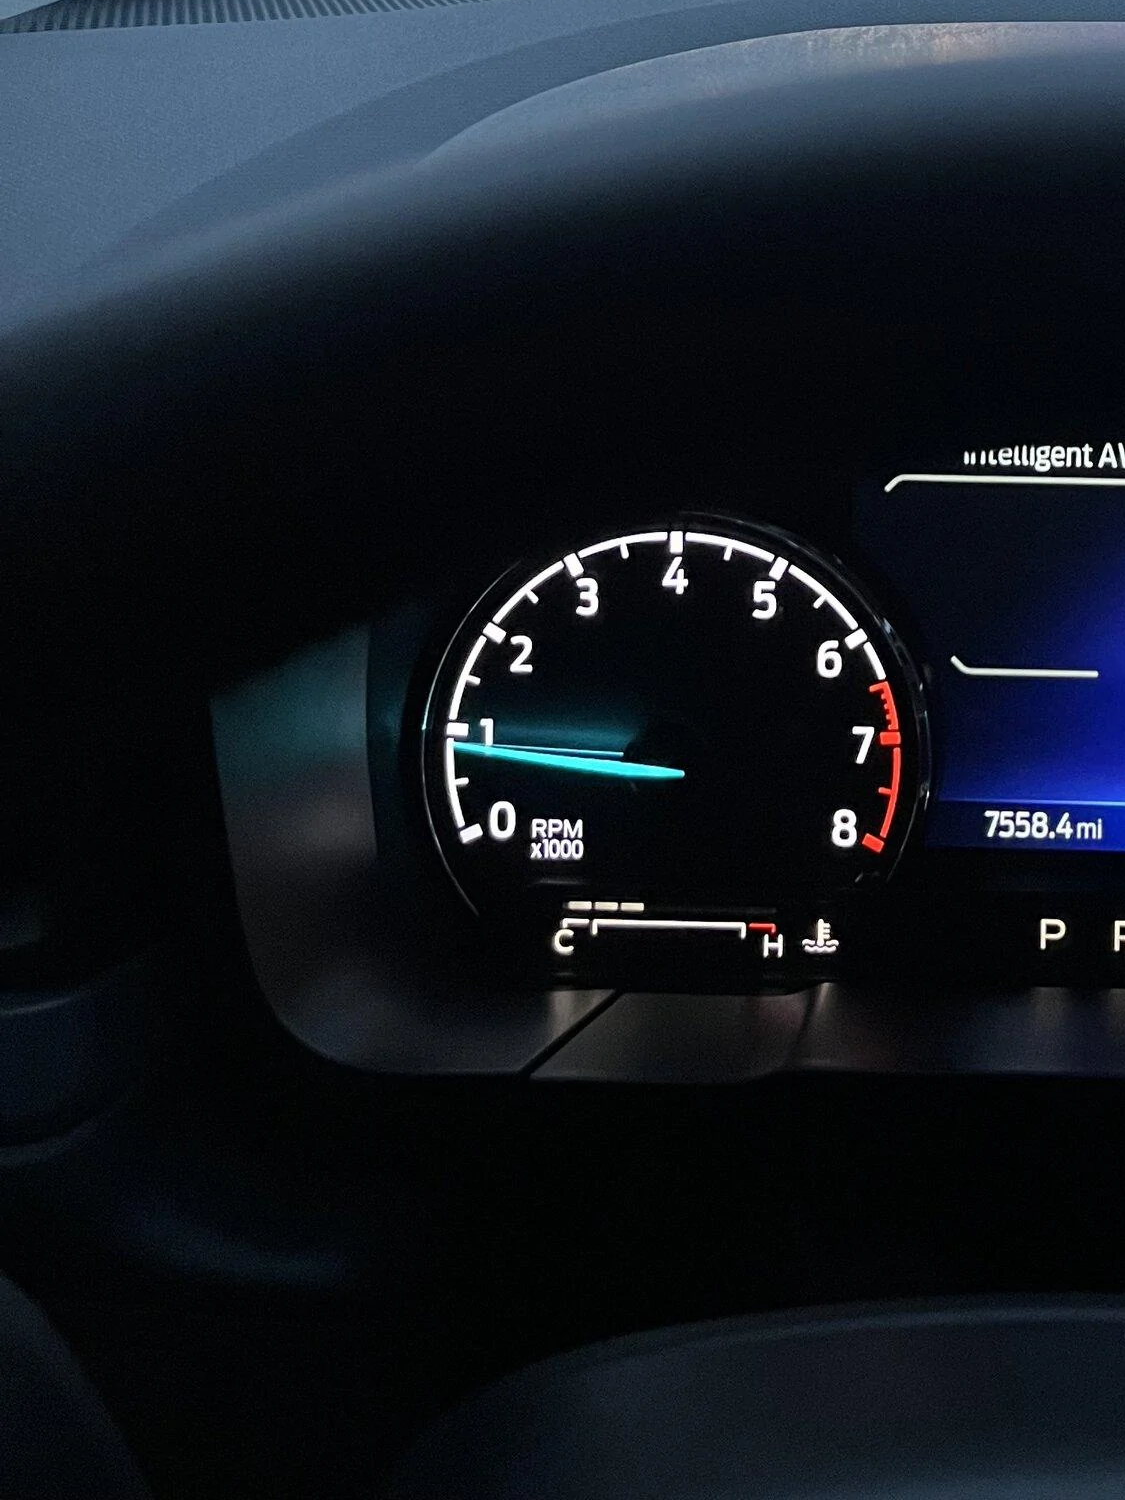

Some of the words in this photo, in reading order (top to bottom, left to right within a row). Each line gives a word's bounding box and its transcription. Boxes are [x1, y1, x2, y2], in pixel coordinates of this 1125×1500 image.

[661, 557, 689, 595] 4
[574, 577, 599, 617] 3
[751, 583, 777, 620] 5
[509, 636, 534, 674] 2
[816, 641, 843, 679] 6
[479, 718, 495, 746] 1
[851, 726, 875, 765] 7
[489, 801, 516, 840] 0
[531, 818, 583, 839] RPM
[831, 809, 858, 848] 8
[530, 840, 585, 860] x1000
[553, 930, 575, 955] C
[763, 934, 784, 958] H
[1040, 918, 1067, 950] P
